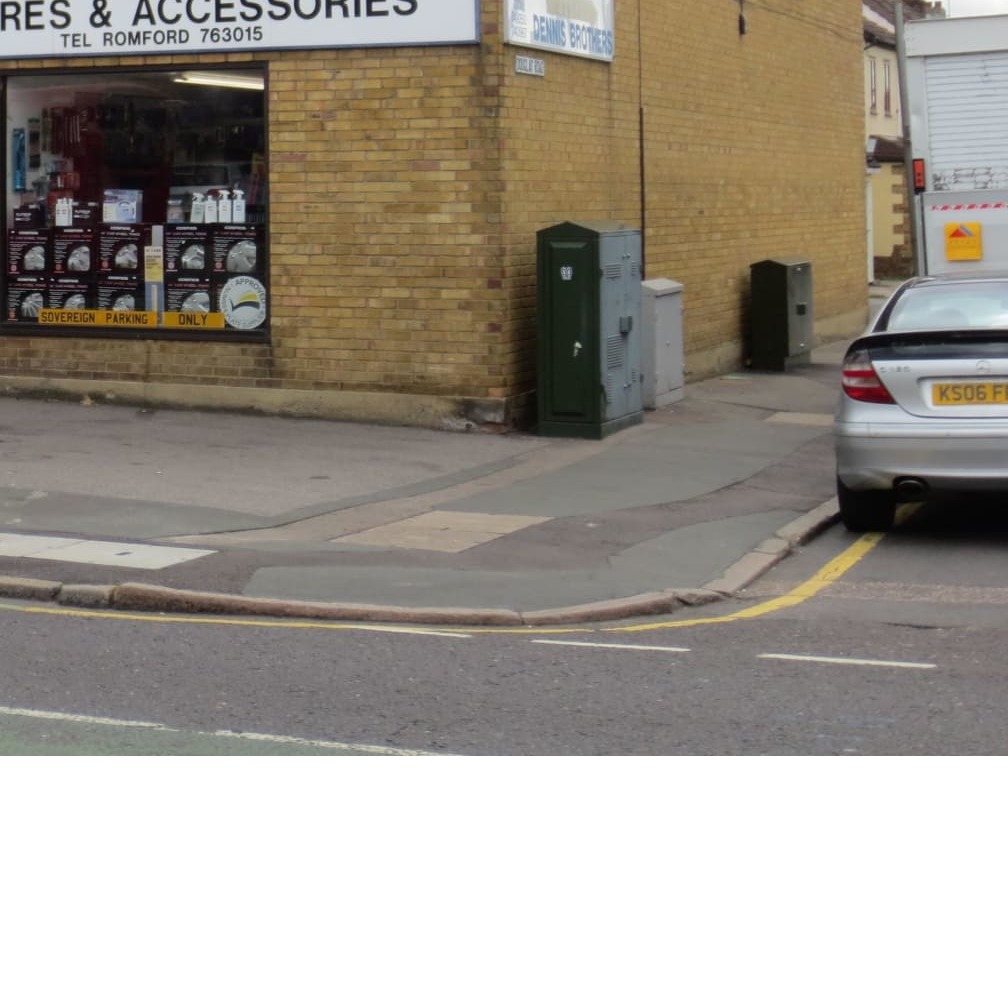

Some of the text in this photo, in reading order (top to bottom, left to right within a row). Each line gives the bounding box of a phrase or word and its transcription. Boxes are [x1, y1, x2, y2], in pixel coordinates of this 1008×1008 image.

[61, 26, 263, 49] TEL ROMFORD 763015
[533, 14, 566, 47] DENNIS
[569, 22, 613, 56] BROTHERS
[42, 312, 209, 326] SOVEREIGN PARKING ONLY
[938, 383, 1008, 401] KS06 F
